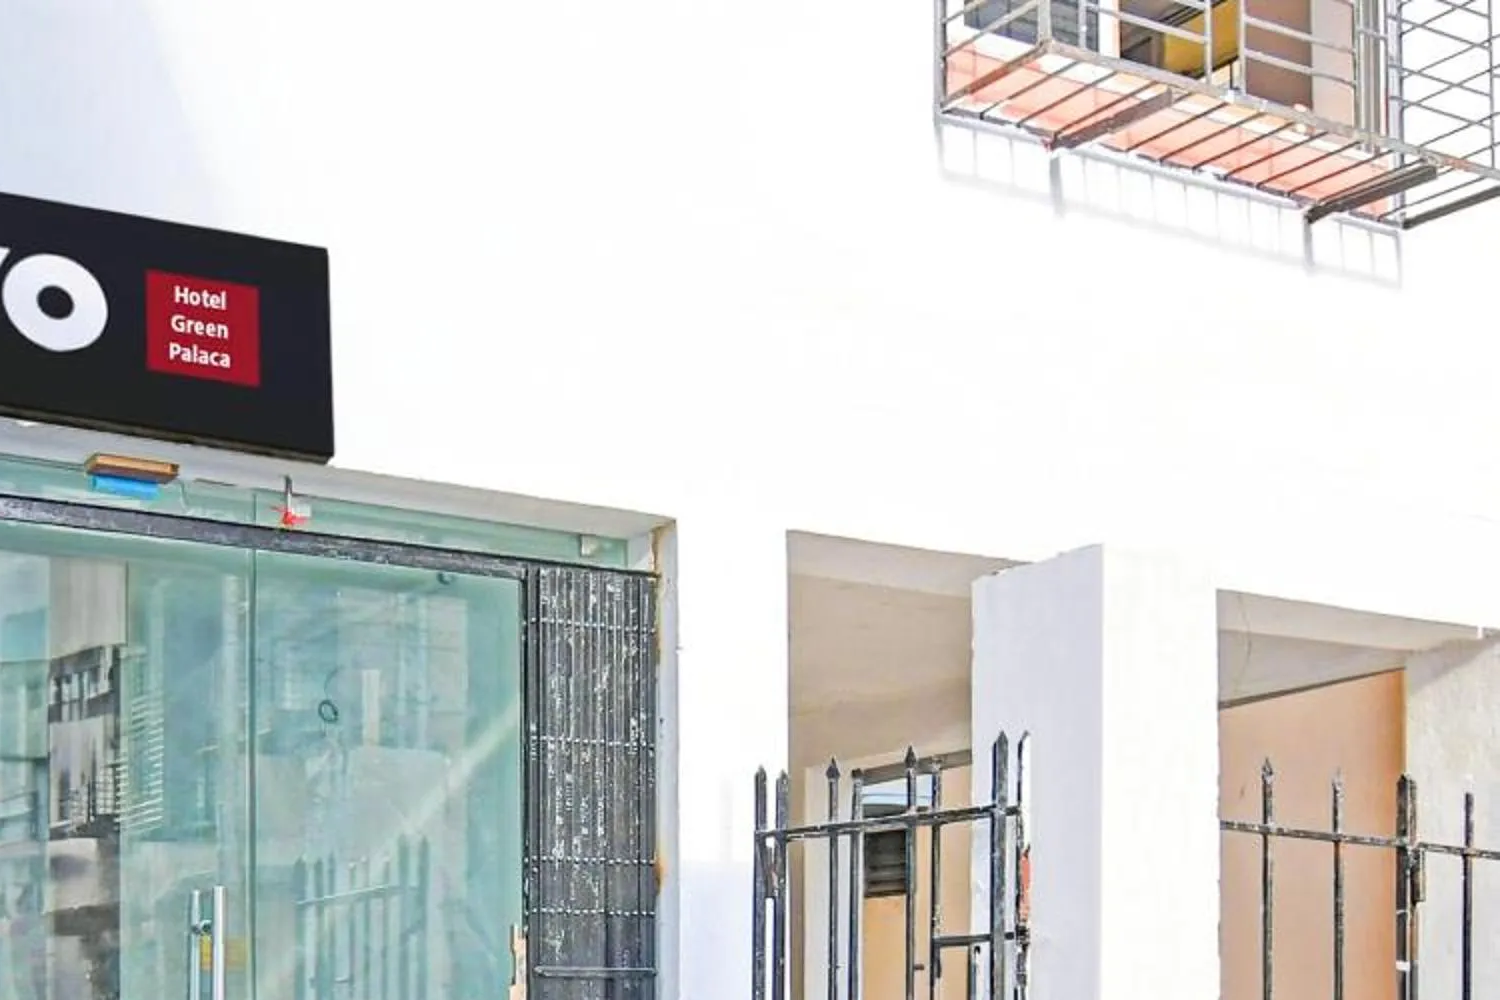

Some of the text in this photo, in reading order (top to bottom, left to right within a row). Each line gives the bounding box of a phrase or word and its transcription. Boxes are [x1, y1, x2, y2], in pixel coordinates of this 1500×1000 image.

[174, 285, 227, 310] Hotel
[171, 314, 229, 339] Green
[169, 342, 231, 368] Palaca
